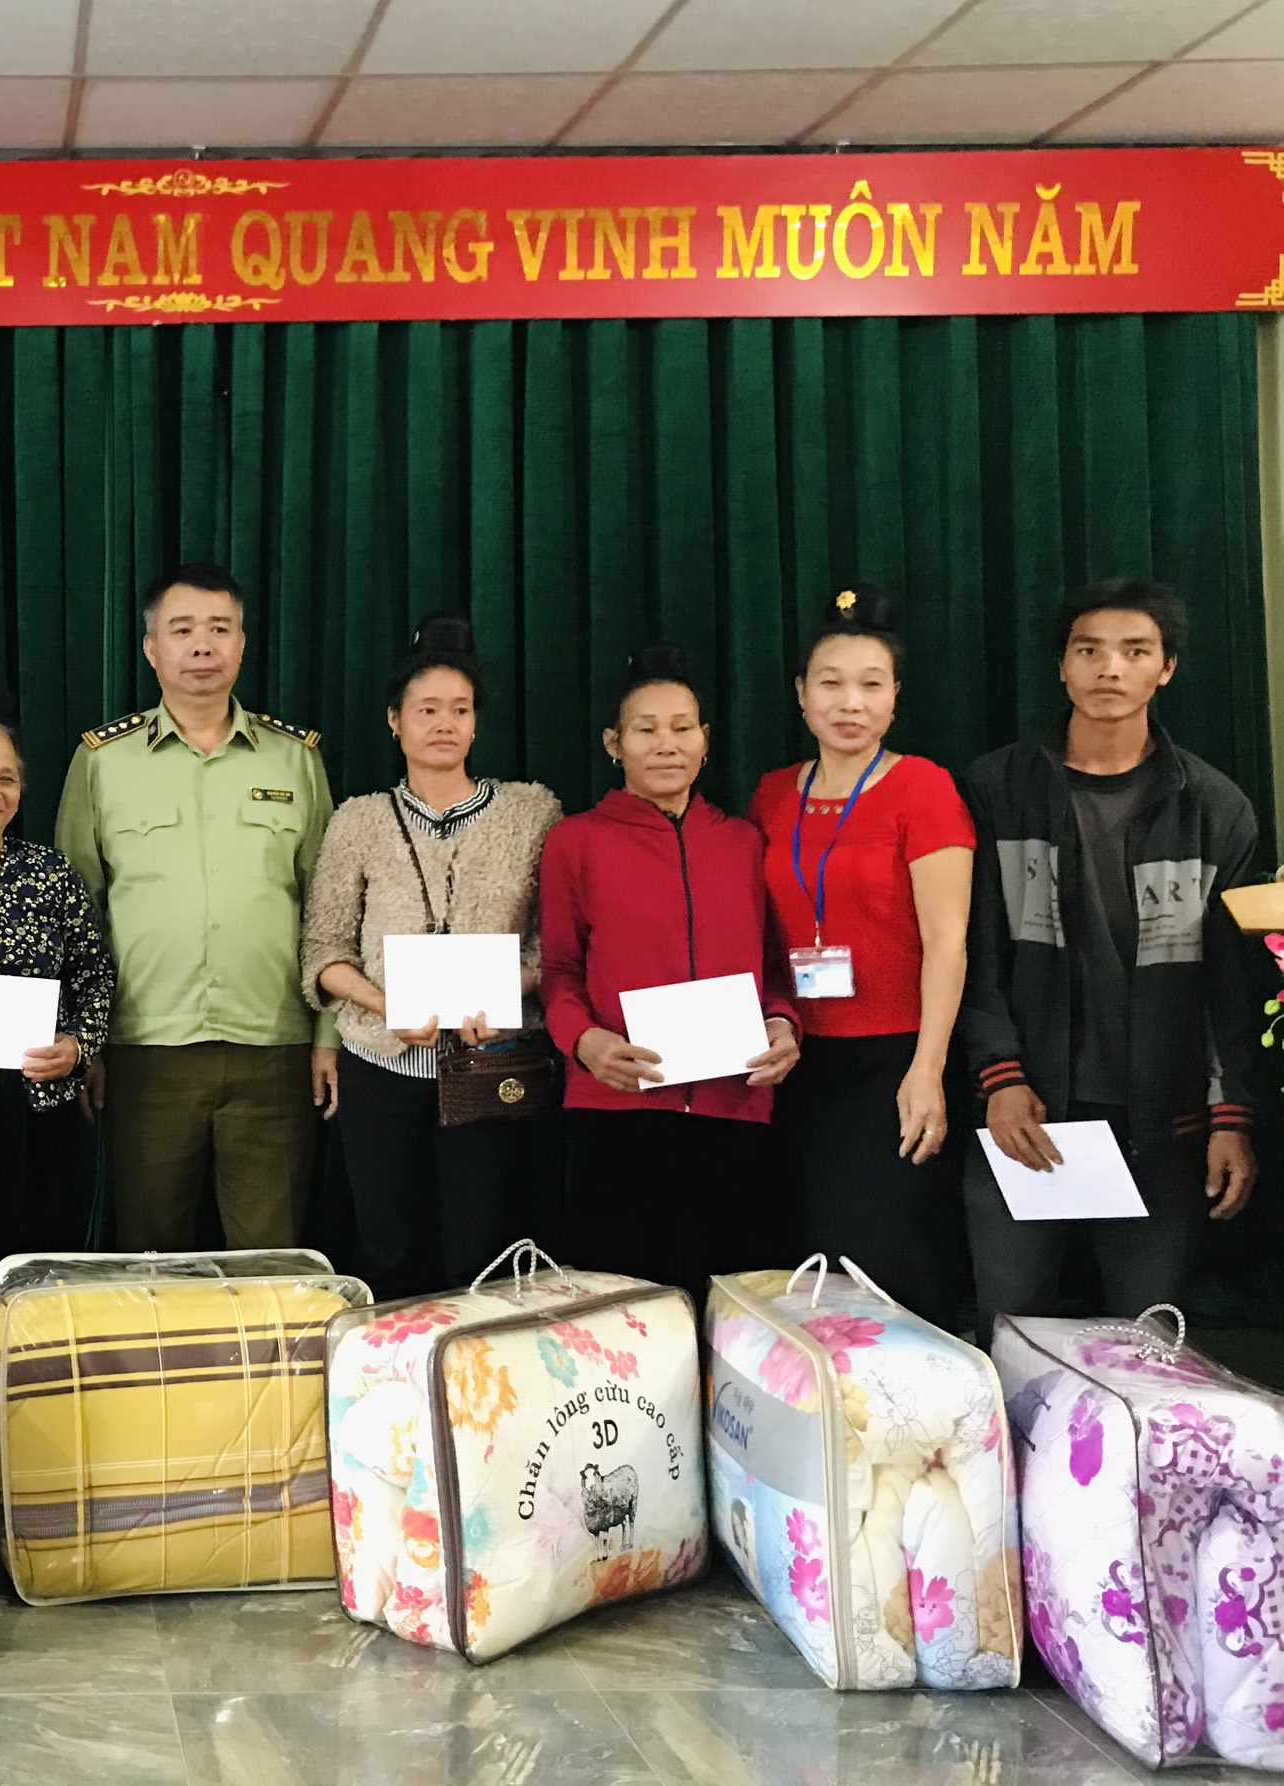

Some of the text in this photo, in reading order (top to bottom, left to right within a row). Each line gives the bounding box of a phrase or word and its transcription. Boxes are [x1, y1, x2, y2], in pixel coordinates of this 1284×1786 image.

[42, 213, 203, 287] NAM
[230, 209, 494, 290] QUANG
[506, 206, 696, 282] VINH
[716, 179, 943, 280] MUÔN
[962, 183, 1141, 276] NĂM
[518, 1379, 685, 1521] Chăn lông cừu cao cấp
[591, 1419, 619, 1449] 3D
